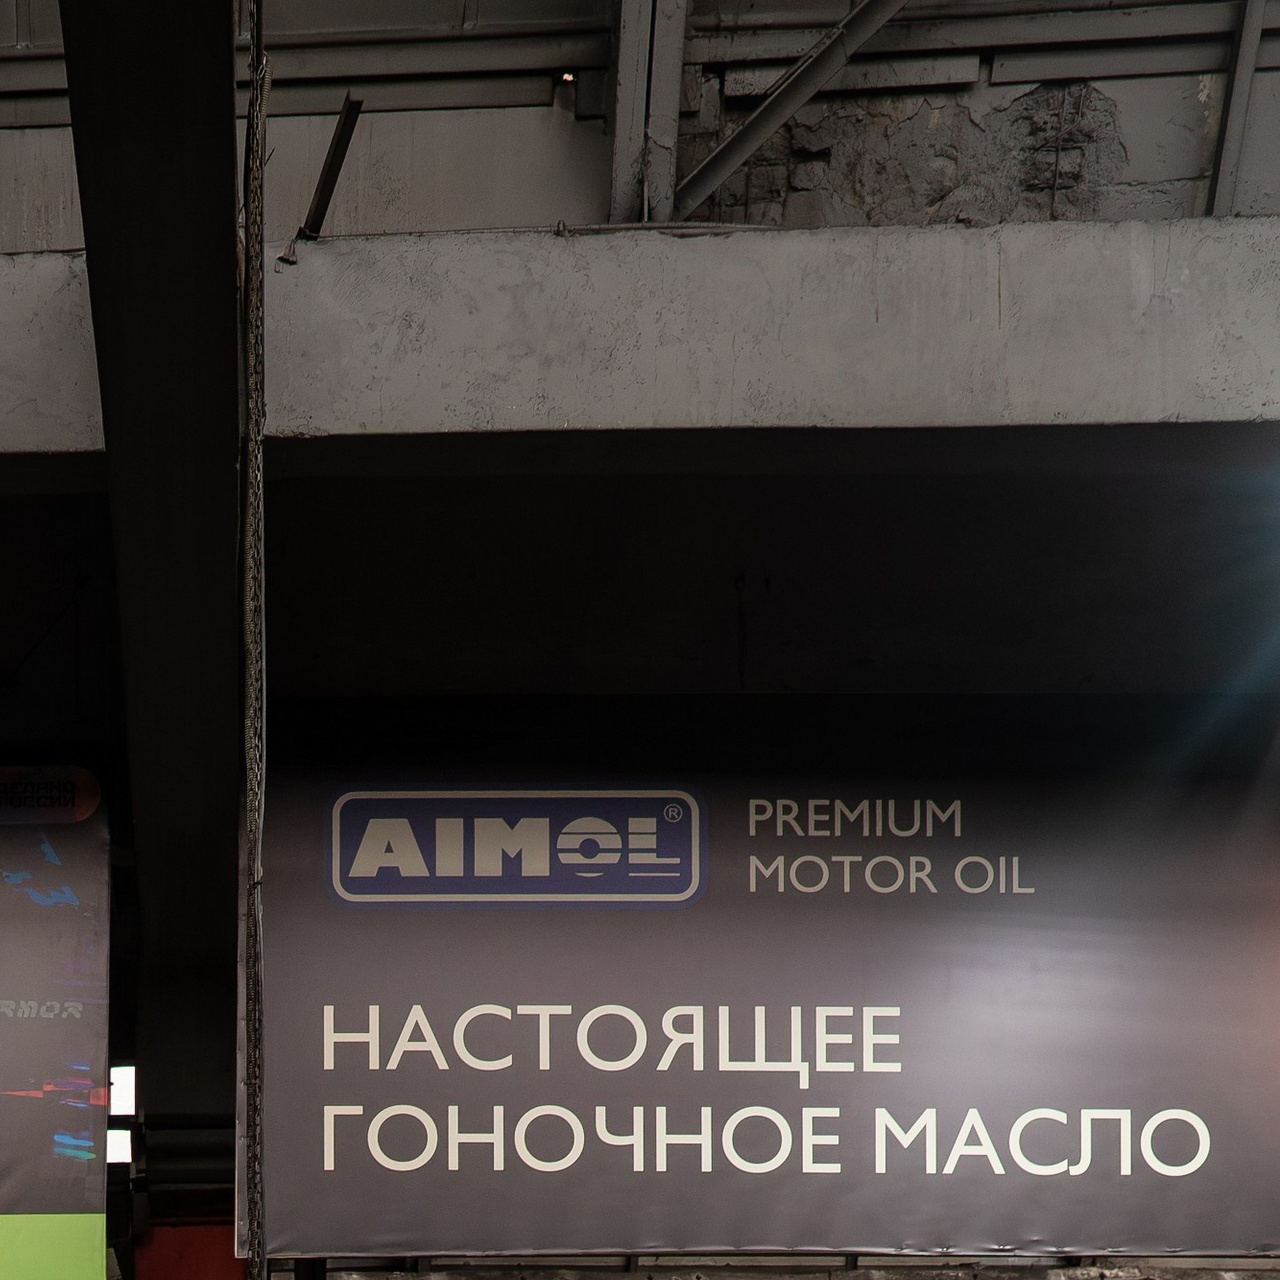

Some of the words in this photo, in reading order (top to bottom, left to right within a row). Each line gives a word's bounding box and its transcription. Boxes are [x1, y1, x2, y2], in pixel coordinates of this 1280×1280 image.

[348, 811, 682, 877] AIMOL
[749, 800, 962, 838] PREMIUM
[749, 855, 939, 894] MOTOR
[954, 855, 1036, 894] OIL
[323, 1004, 902, 1089] НАСТОЯЩЕЕ
[323, 1104, 842, 1174] ГОНОЧНОЕ
[874, 1107, 1211, 1177] МАСЛО
